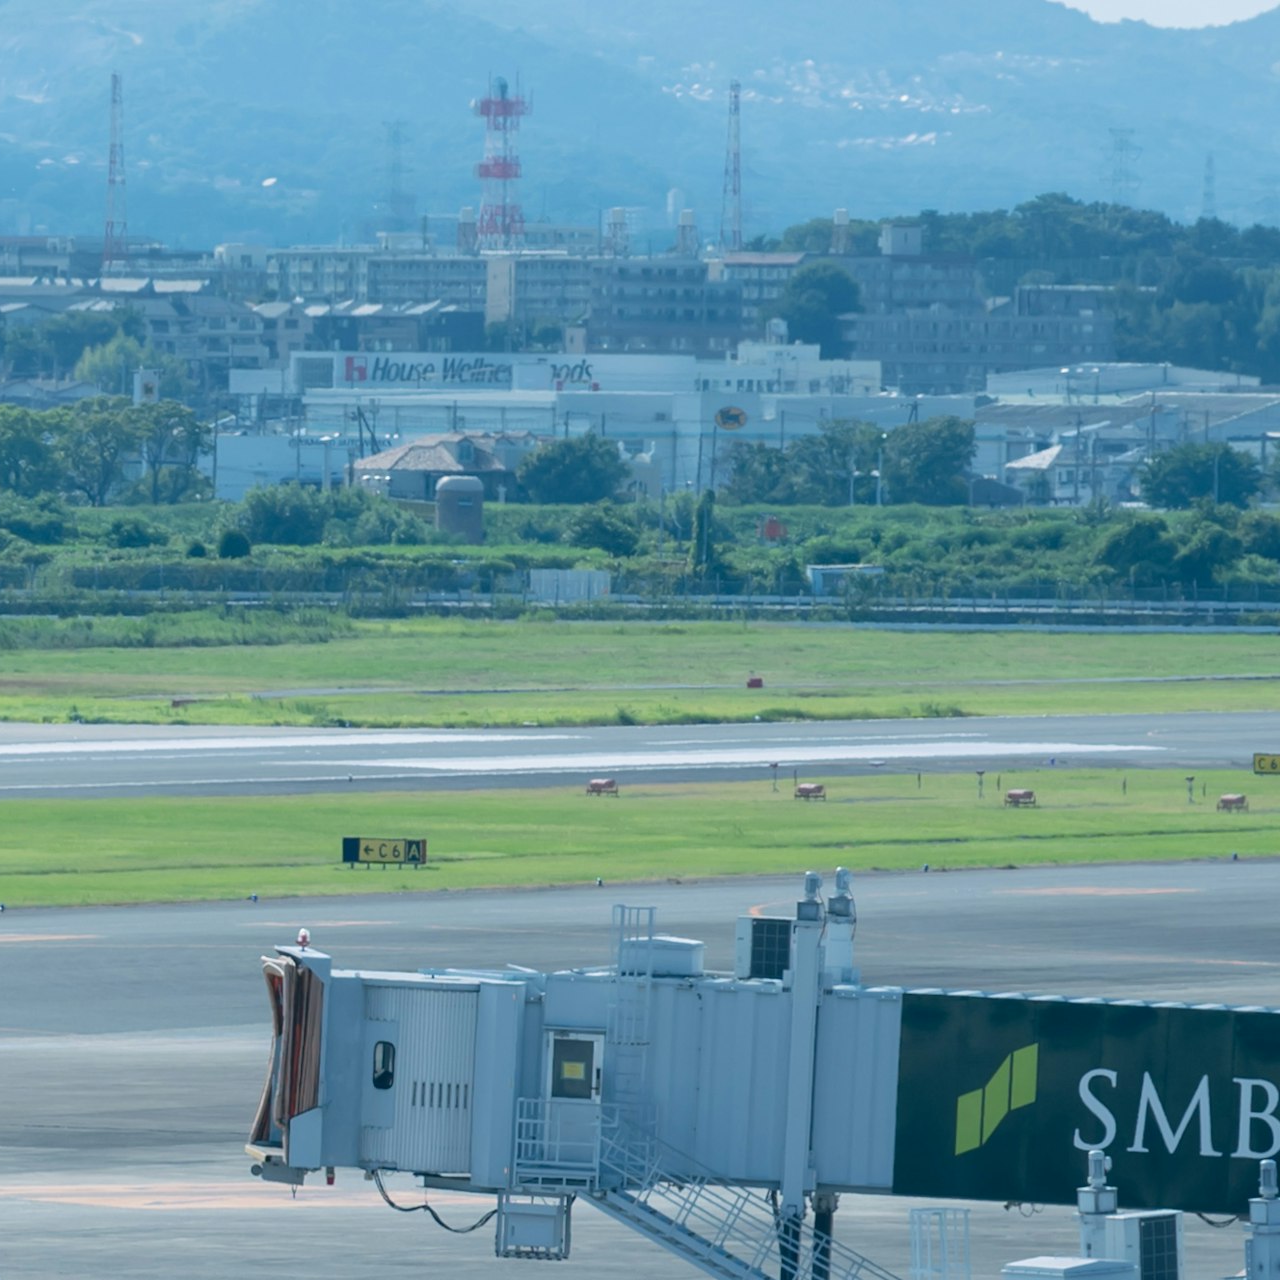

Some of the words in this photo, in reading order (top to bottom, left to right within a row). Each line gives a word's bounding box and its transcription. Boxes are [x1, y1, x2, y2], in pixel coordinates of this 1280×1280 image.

[372, 356, 435, 382] House
[408, 843, 420, 859] A
[1073, 1068, 1280, 1159] SMB
